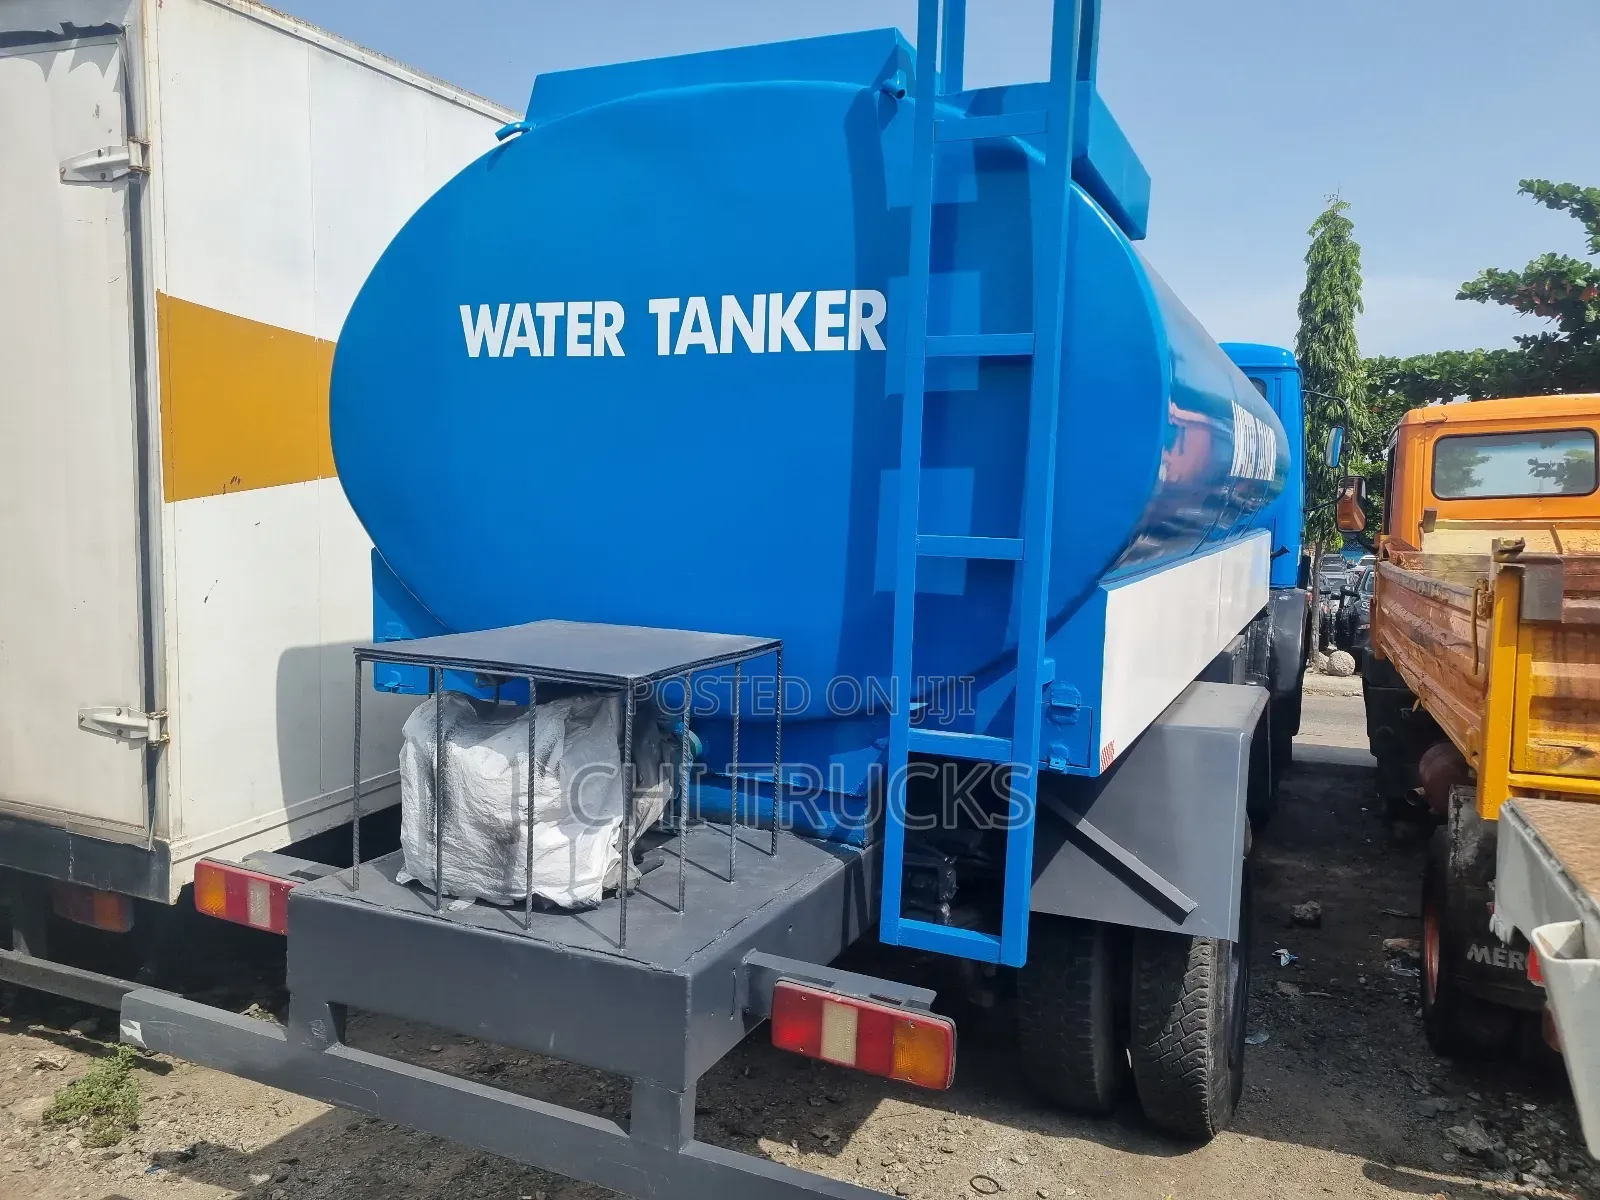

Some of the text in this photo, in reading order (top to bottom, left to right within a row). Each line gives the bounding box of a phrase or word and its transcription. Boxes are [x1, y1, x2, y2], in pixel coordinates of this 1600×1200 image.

[459, 289, 888, 358] WATER TANKER
[1466, 943, 1528, 971] MER
